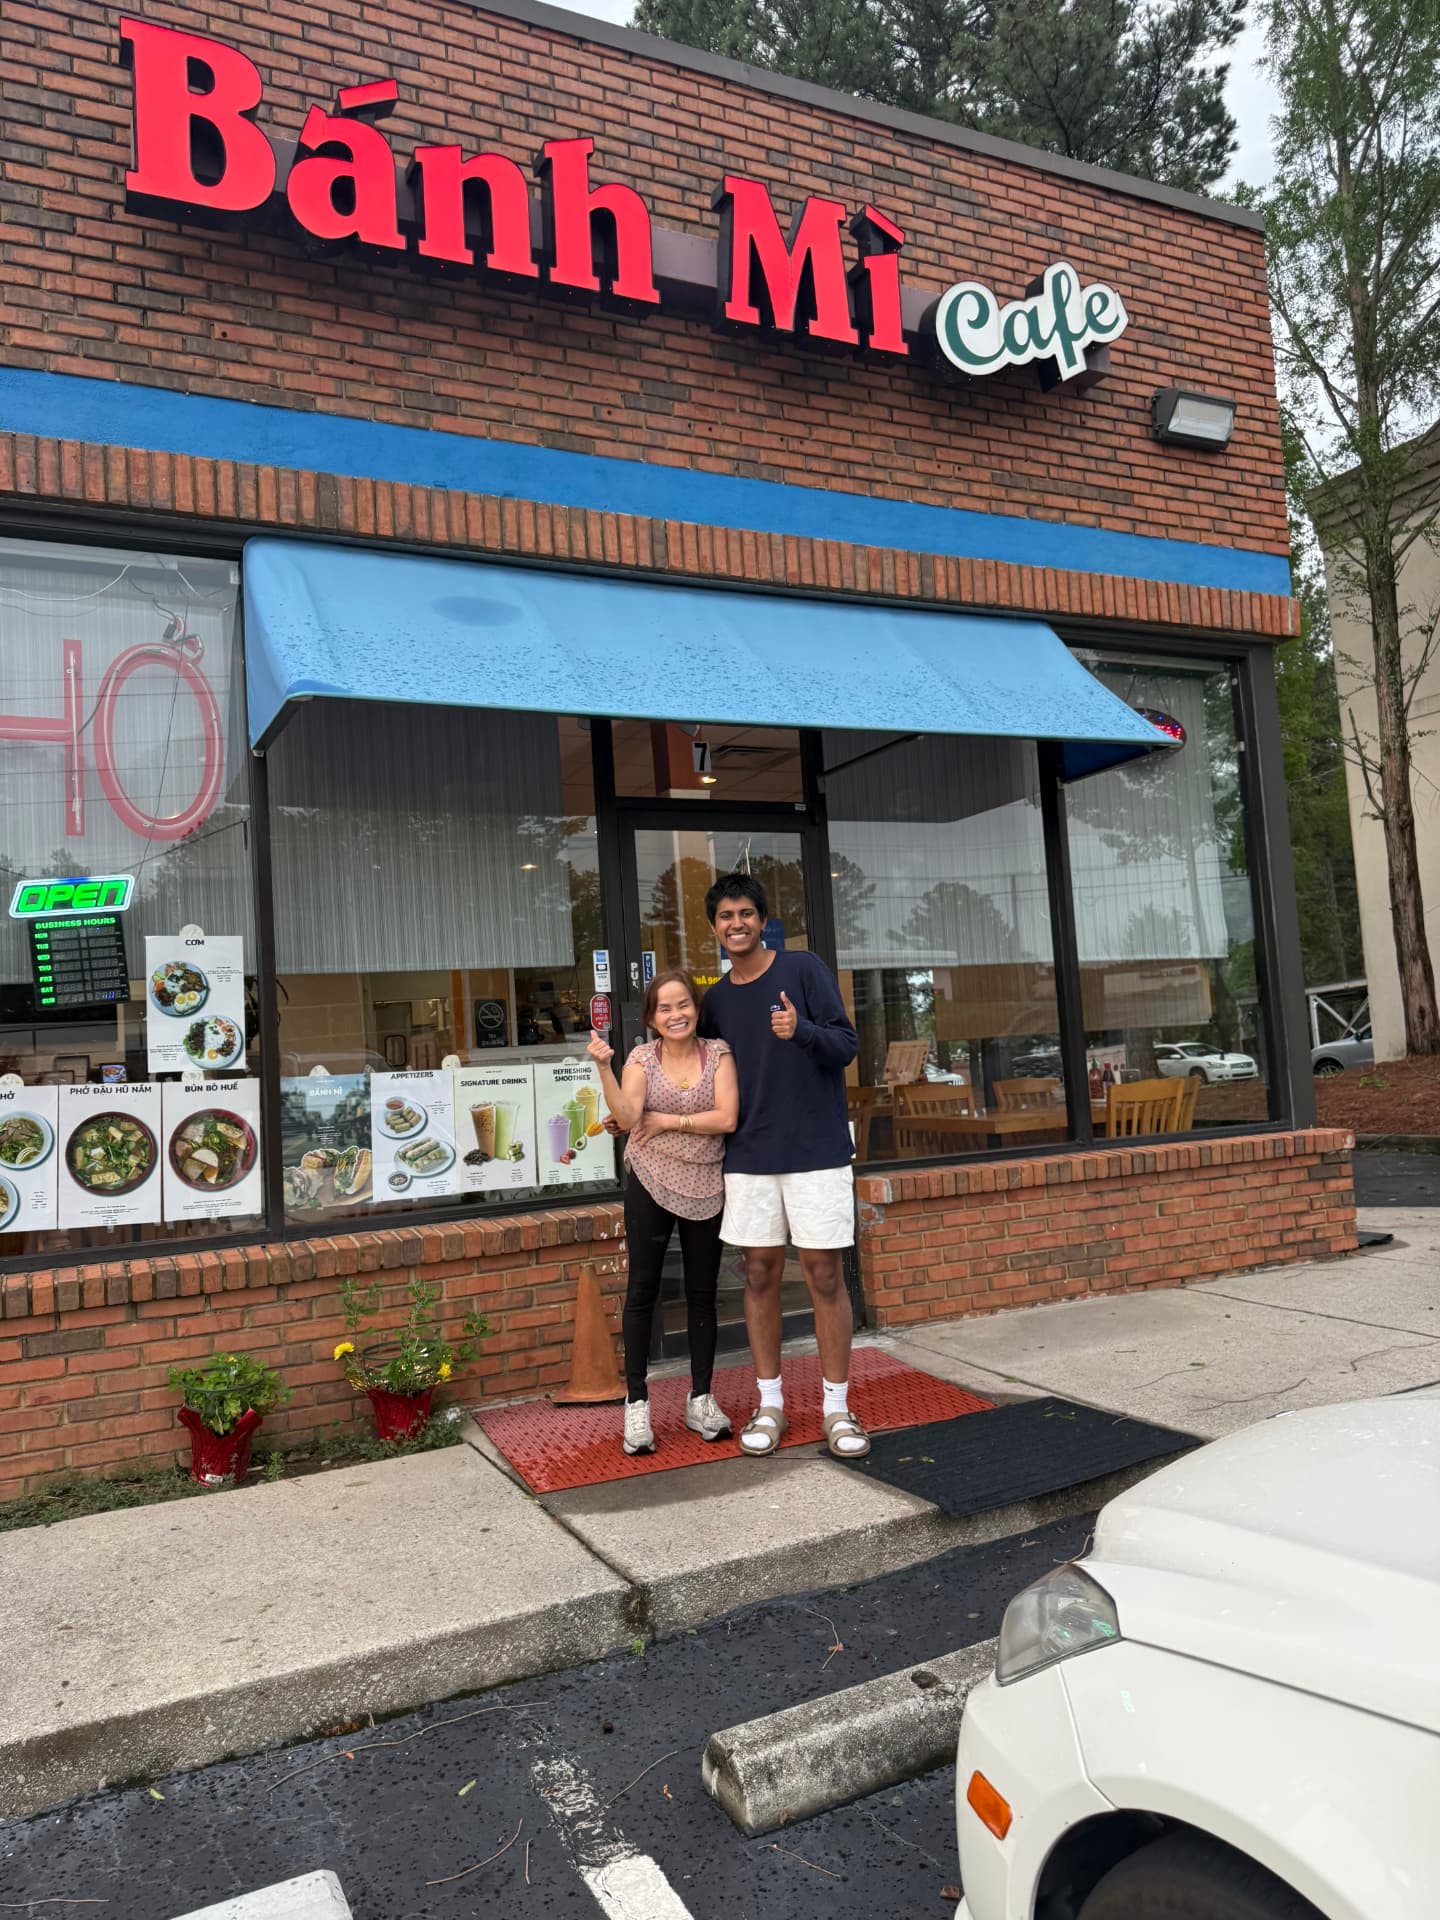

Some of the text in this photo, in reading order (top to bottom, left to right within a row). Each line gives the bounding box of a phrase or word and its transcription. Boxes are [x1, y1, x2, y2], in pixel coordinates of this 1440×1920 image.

[120, 16, 1124, 377] Bánh Mì Cafe
[694, 742, 708, 771] 7
[17, 879, 127, 913] OPEN
[35, 917, 116, 930] BUSINESS HOURS
[390, 1071, 434, 1080] APPETIZERS
[553, 1067, 592, 1075] REFRESHING
[460, 1076, 528, 1087] SIGNATURE DRINKS
[554, 1074, 591, 1082] SMOOTHIES
